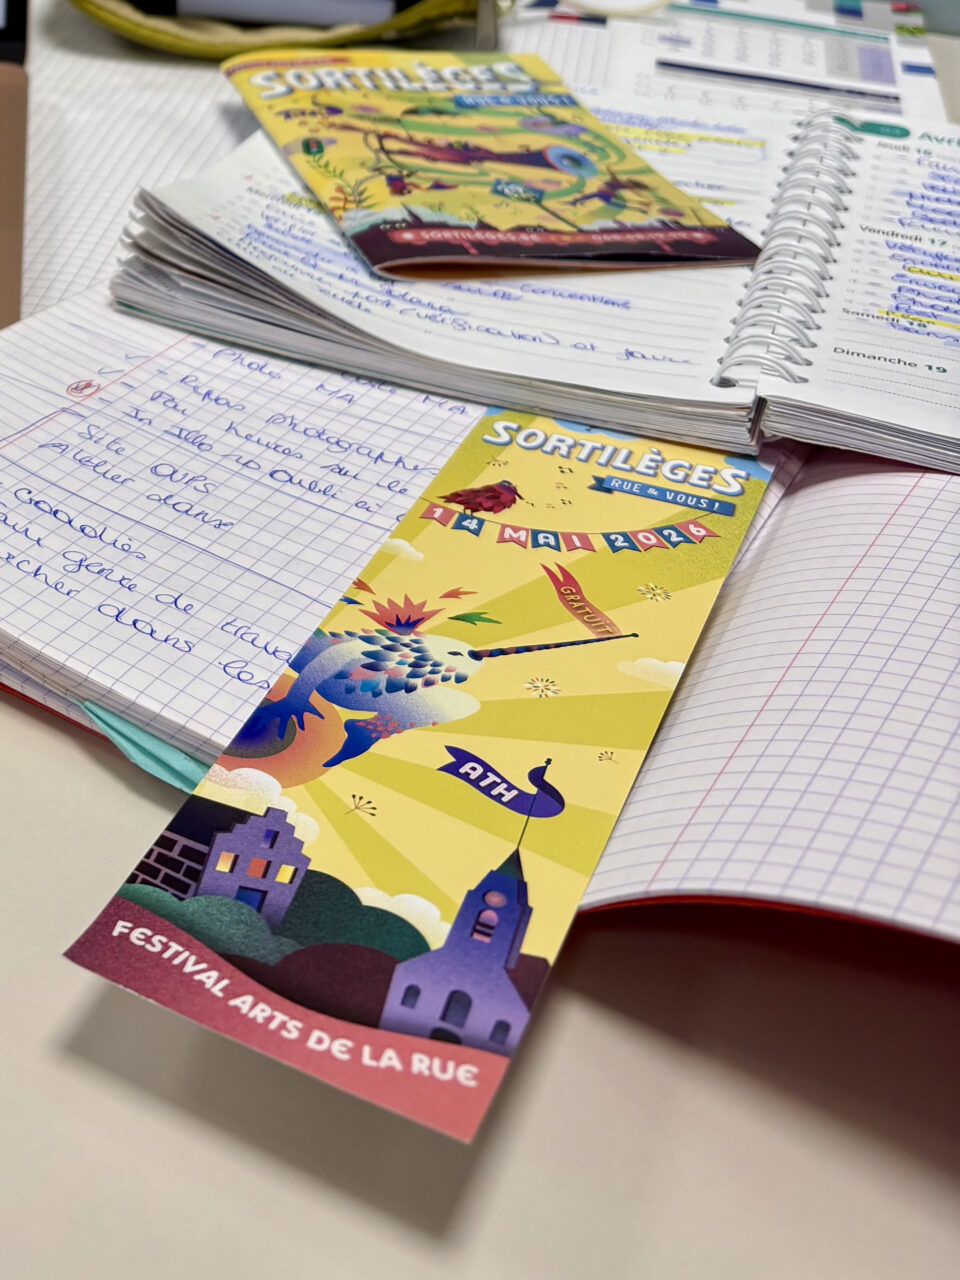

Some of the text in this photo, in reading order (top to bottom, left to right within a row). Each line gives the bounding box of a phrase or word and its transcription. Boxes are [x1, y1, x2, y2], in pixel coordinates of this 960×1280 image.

[250, 61, 537, 100] SORTILÈGES
[859, 224, 923, 243] Vendredi
[841, 307, 900, 324] Samedi
[213, 347, 282, 380] Photo
[833, 346, 948, 374] Dimanche 19
[180, 374, 246, 412] Repas
[77, 423, 127, 457] Site
[481, 418, 750, 498] SORTILÈGES
[38, 440, 136, 486] Atelier
[609, 477, 641, 493] RUE
[646, 486, 660, 496] &
[432, 506, 707, 550] 14 MAI 2026
[62, 549, 138, 593] genre
[155, 591, 195, 616] de
[220, 615, 294, 665] trava
[558, 584, 615, 636] GRATUIT
[97, 602, 196, 654] dans
[217, 658, 273, 692] les
[458, 761, 519, 803] ATH
[111, 919, 480, 1089] FESTIVAL ARTS DE LA RUE
